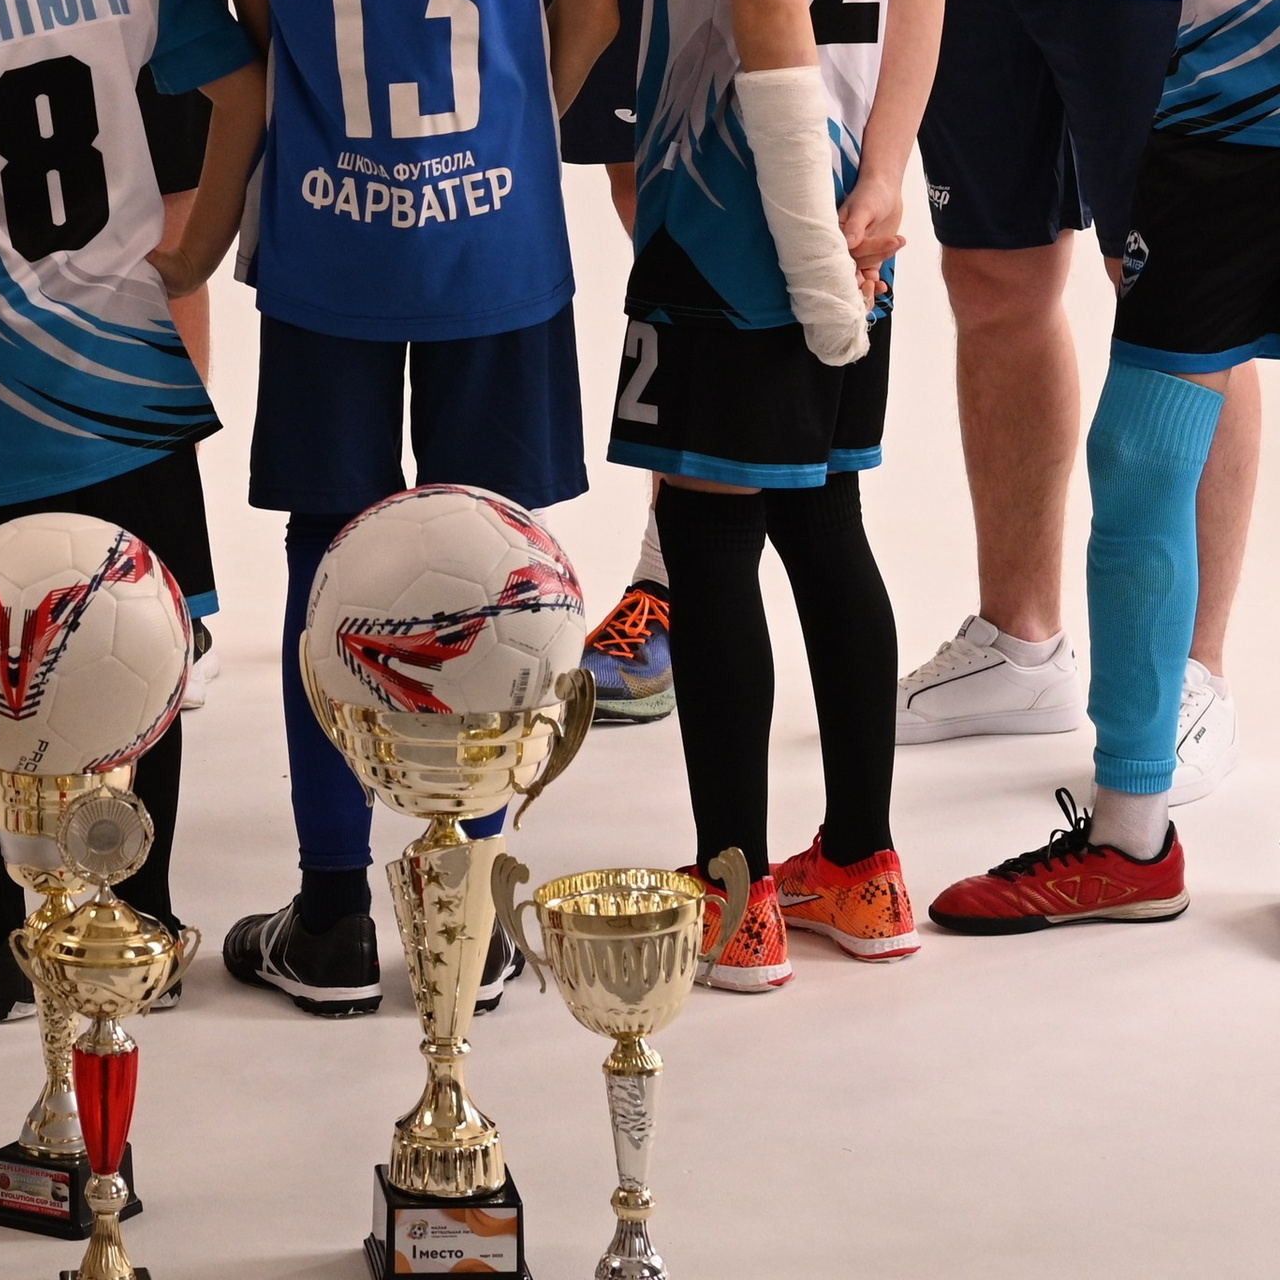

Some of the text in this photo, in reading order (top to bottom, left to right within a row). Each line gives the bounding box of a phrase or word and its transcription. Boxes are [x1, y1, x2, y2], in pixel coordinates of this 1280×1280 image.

[337, 150, 476, 182] ШКОЛА ФУТБОЛА
[301, 166, 513, 229] ФАРВАТЕР
[617, 320, 659, 425] 2
[24, 739, 49, 773] PRO
[419, 1250, 464, 1259] место
